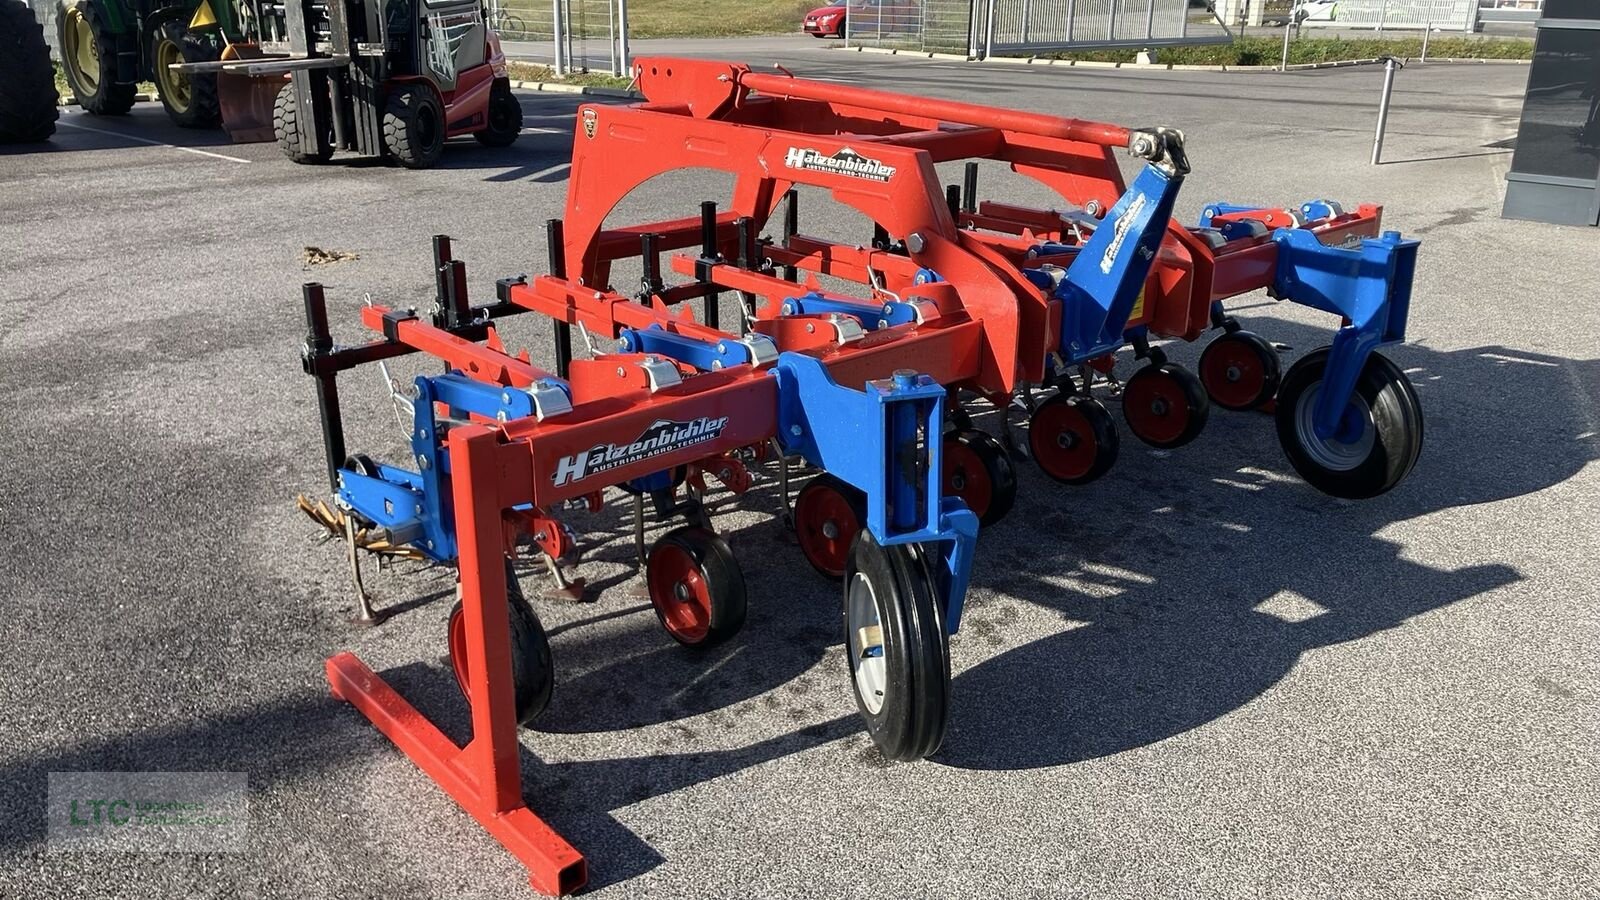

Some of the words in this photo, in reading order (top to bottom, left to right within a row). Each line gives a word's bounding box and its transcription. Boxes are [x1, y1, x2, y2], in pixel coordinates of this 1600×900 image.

[785, 146, 897, 177] Hatzenbichler
[553, 416, 728, 487] Hatzenbichler
[592, 433, 715, 474] AUSTRIAN-AGRO-TECHNIK
